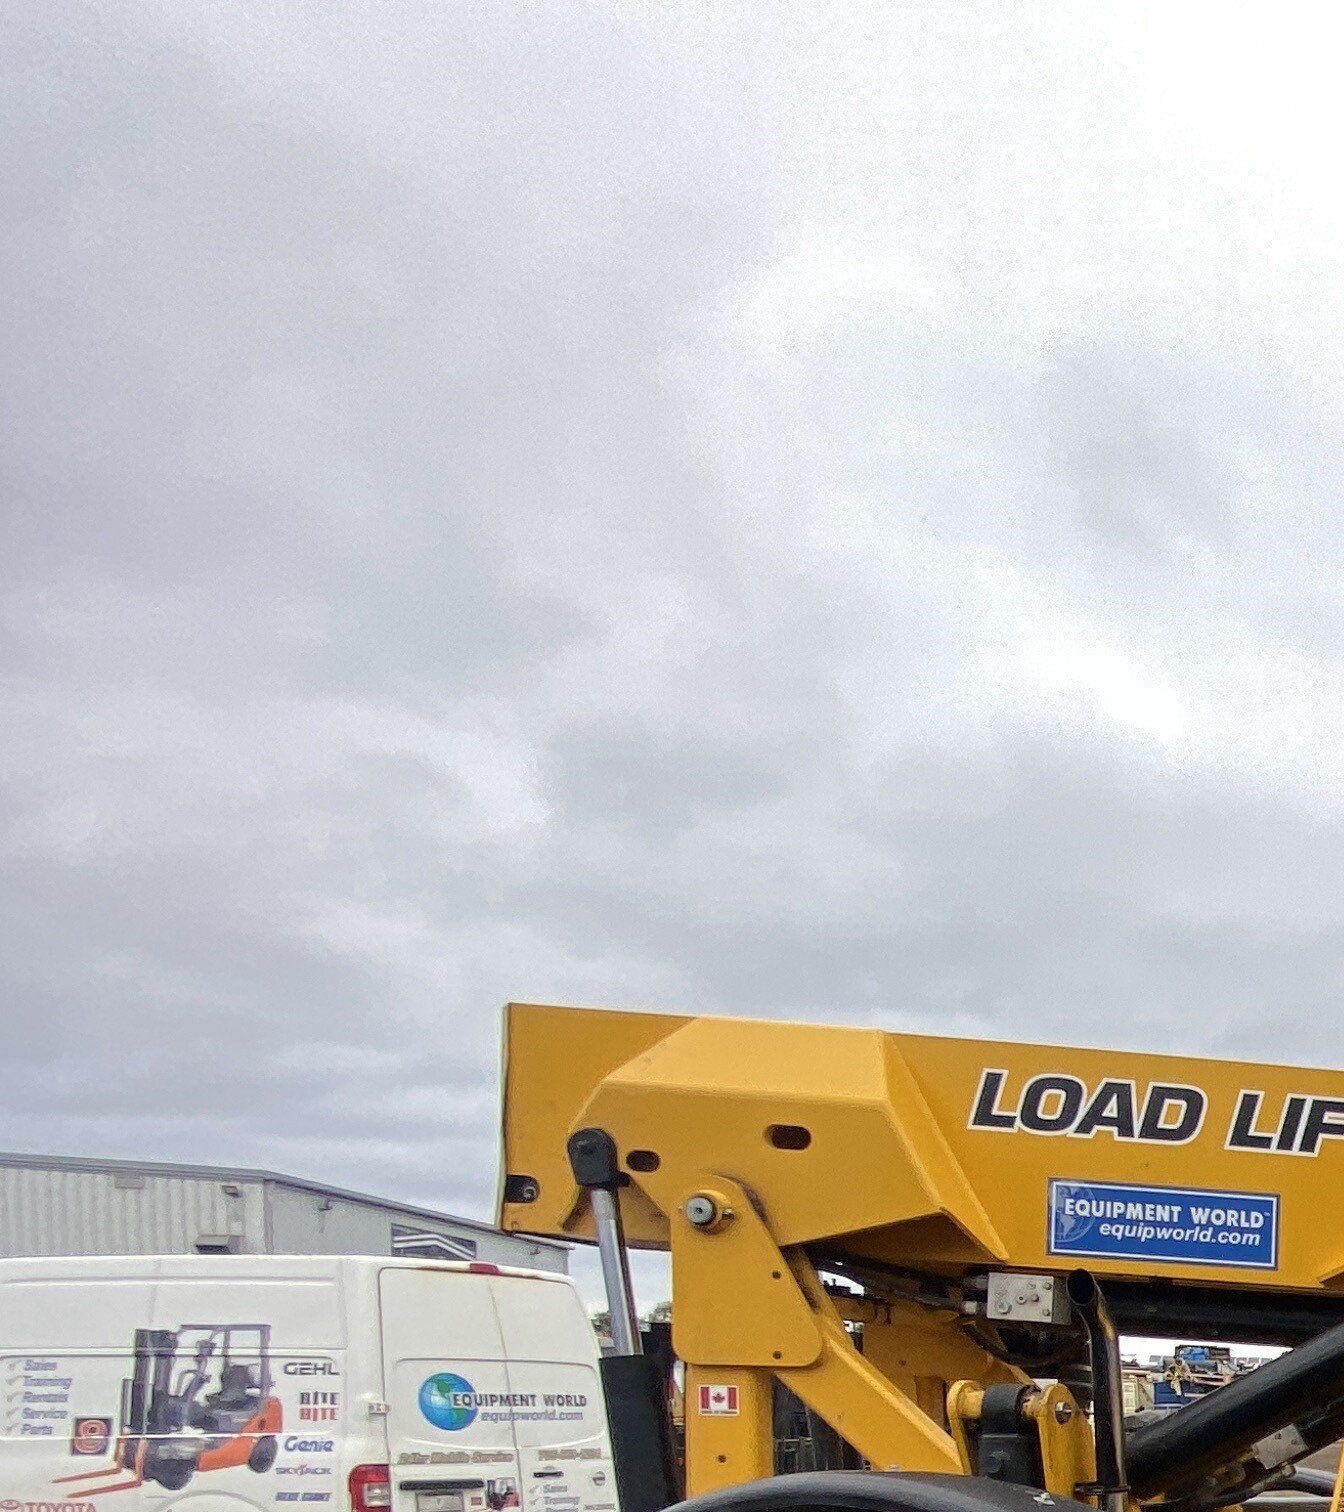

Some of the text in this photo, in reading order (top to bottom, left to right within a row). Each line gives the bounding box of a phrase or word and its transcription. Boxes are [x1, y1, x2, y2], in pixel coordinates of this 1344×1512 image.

[967, 1067, 1208, 1145] LOAD
[1064, 1199, 1265, 1229] EQUIPMENT WORLD
[1099, 1221, 1261, 1246] equipworld.com
[283, 1362, 340, 1376] GEHL
[453, 1393, 588, 1408] EQUIPMENT WORLD
[481, 1409, 584, 1424] equipworld.com
[284, 1435, 334, 1452] Genie
